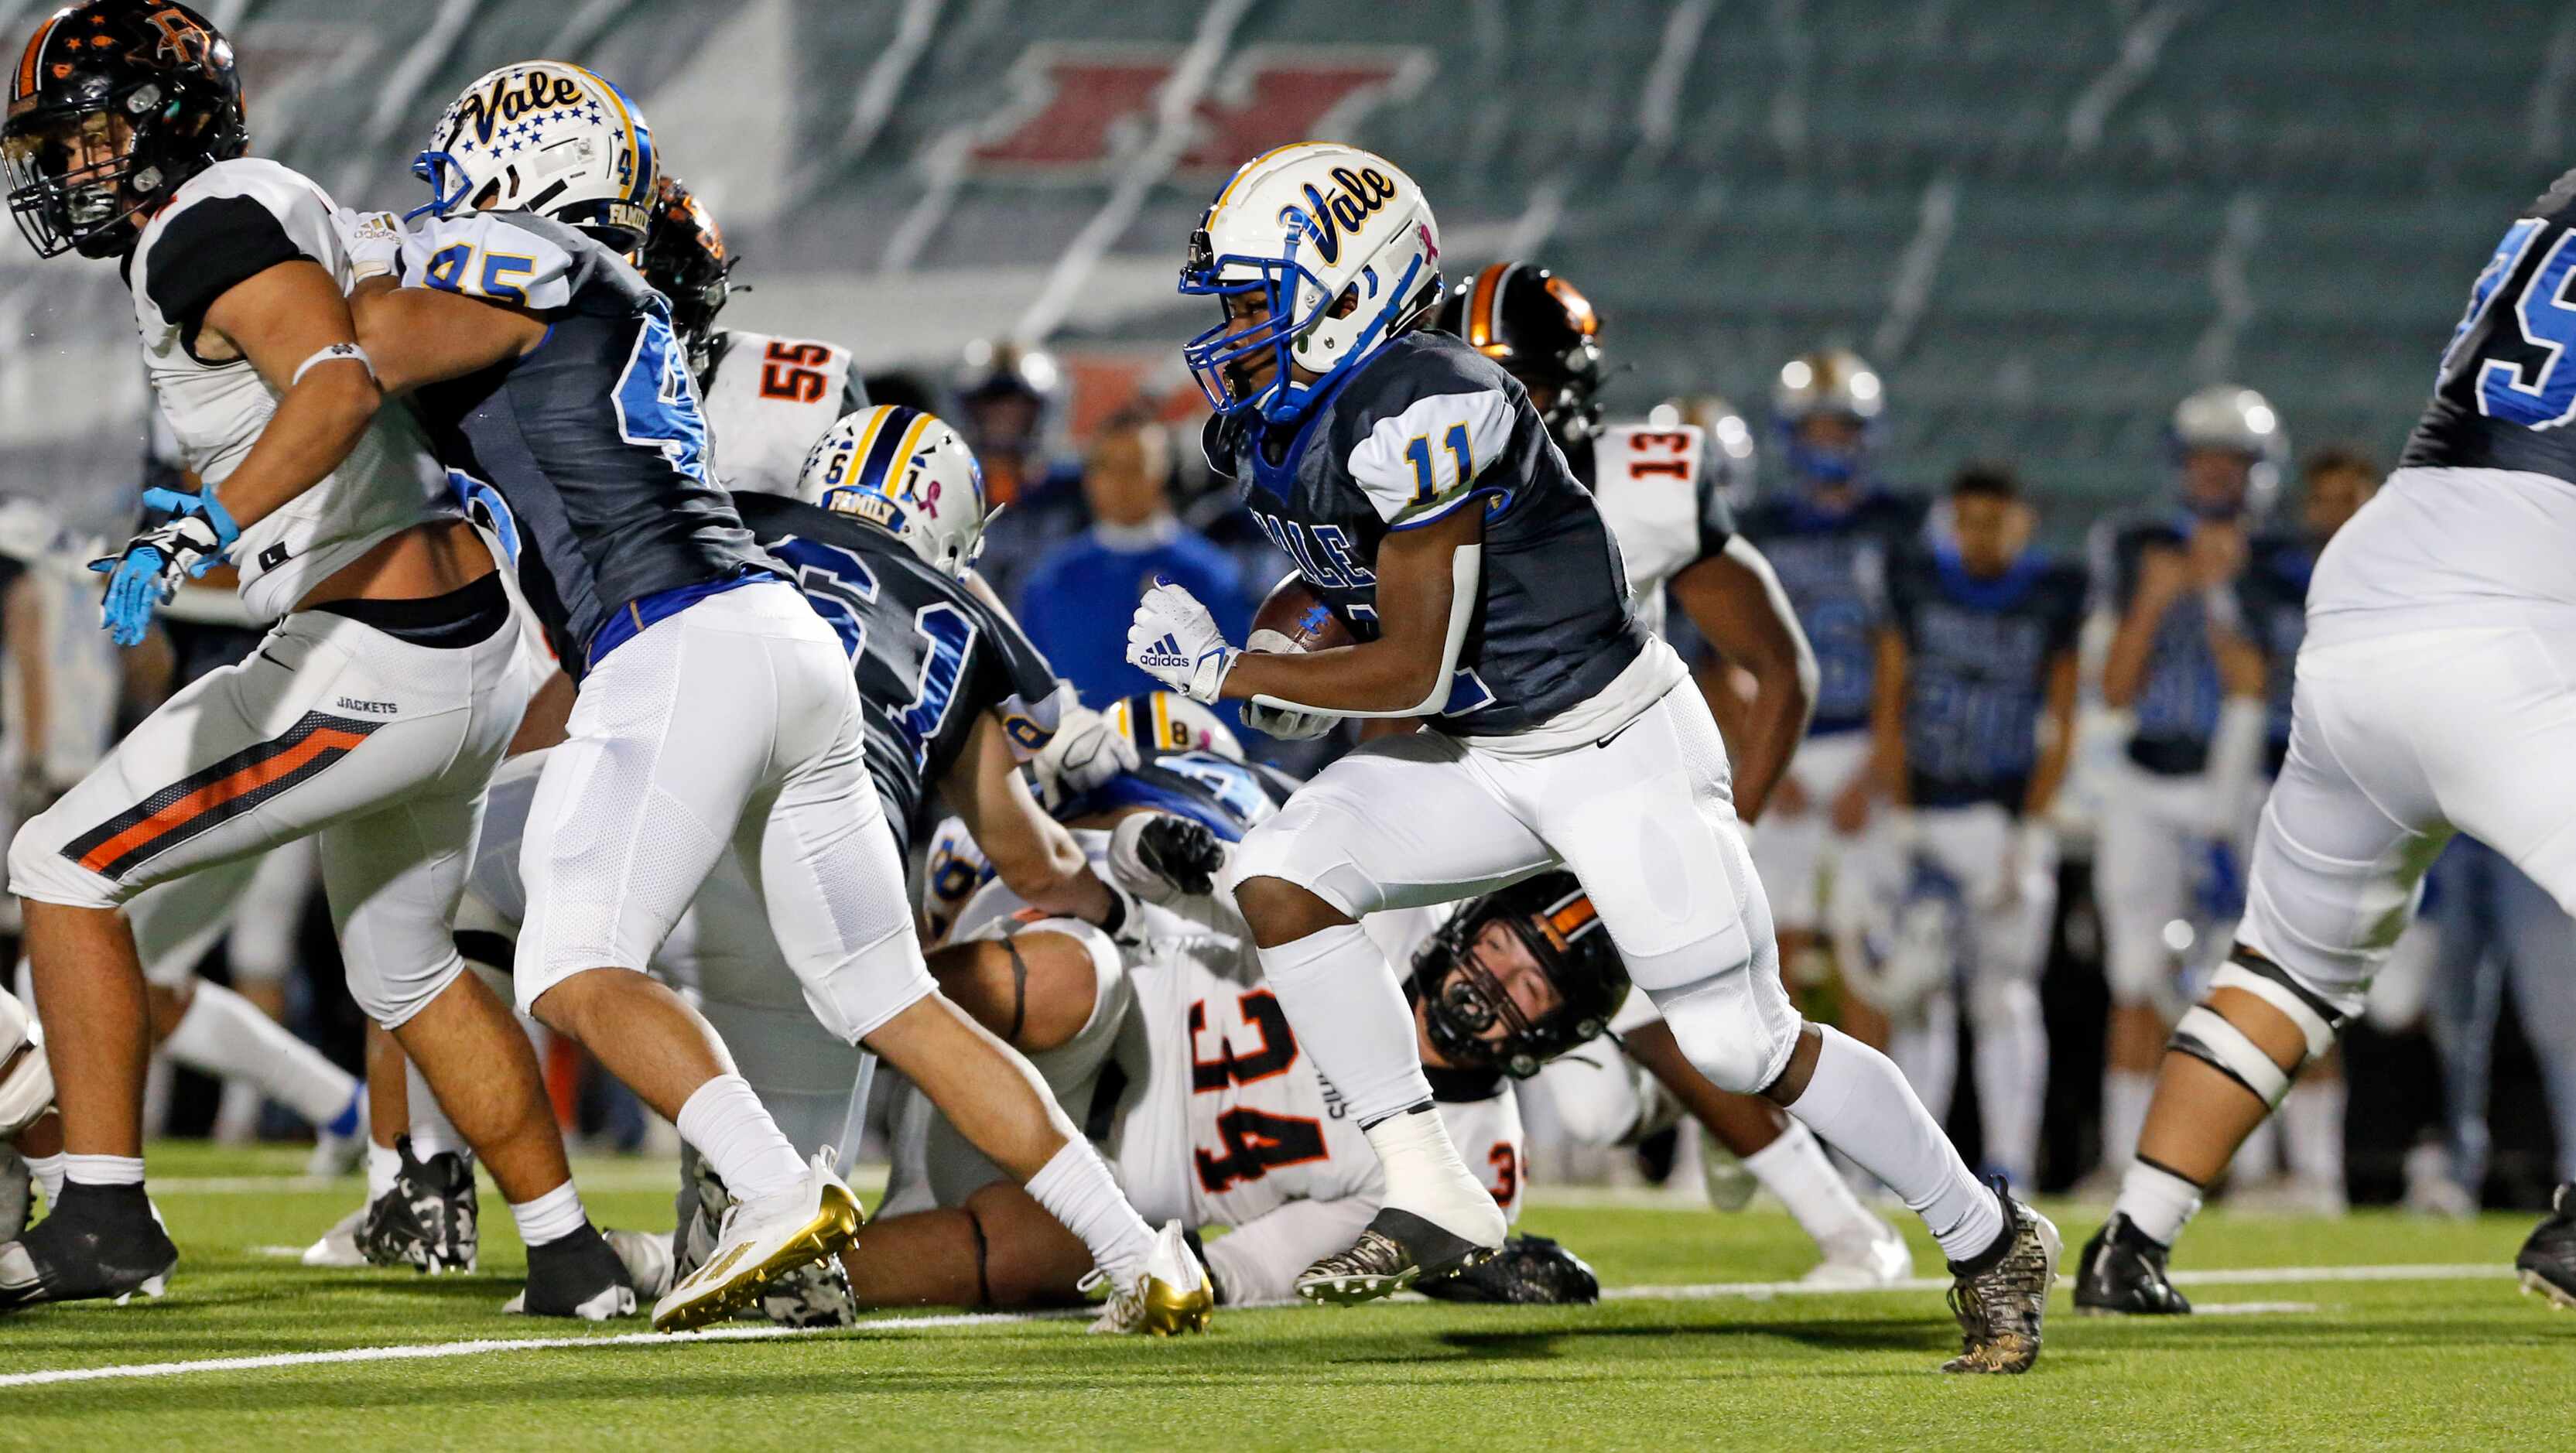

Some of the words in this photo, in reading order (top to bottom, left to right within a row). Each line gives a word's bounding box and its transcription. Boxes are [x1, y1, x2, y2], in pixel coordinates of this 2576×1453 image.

[459, 70, 586, 148] Vale
[1276, 165, 1399, 268] Vale
[420, 241, 538, 308] 45
[759, 340, 833, 404] 55
[1403, 420, 1477, 507] 11
[1629, 432, 1690, 480] 13
[828, 490, 897, 527] FAMILY
[1140, 654, 1189, 667] adidas
[337, 696, 398, 713] JACKETS
[1189, 988, 1330, 1194] 34
